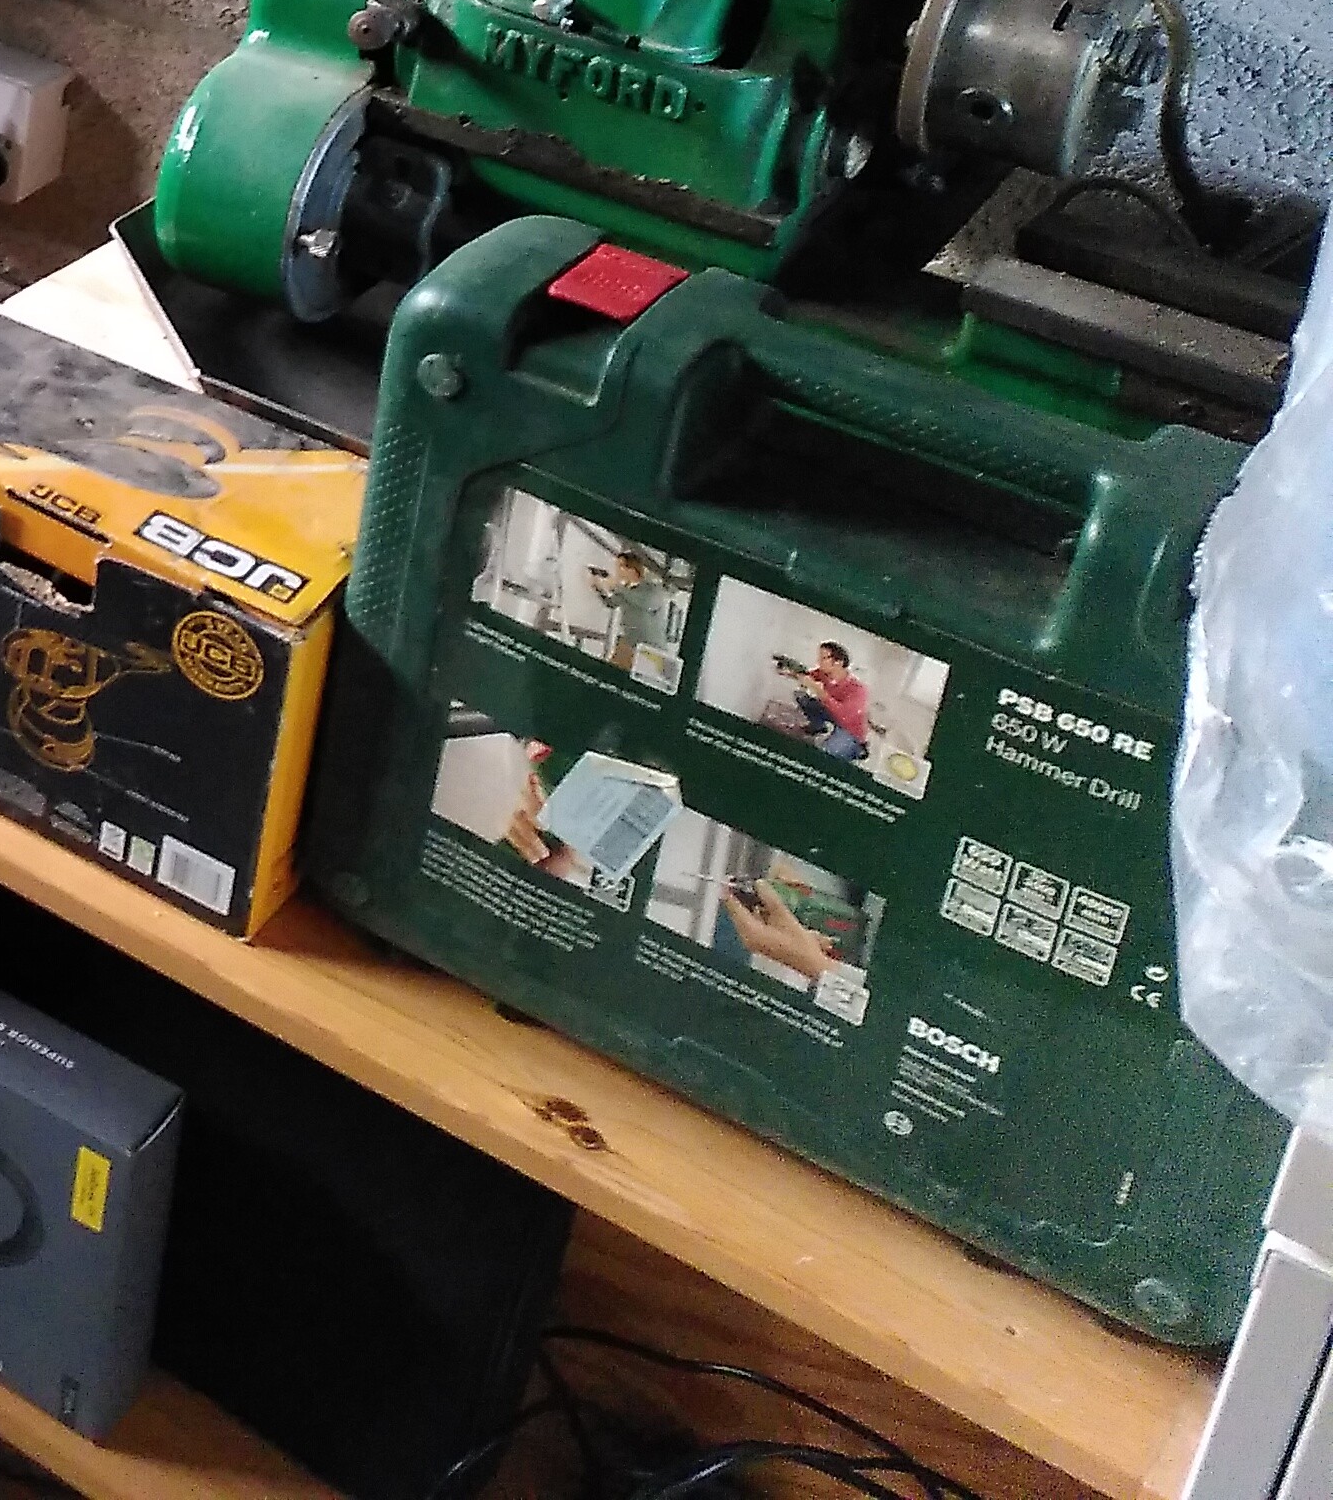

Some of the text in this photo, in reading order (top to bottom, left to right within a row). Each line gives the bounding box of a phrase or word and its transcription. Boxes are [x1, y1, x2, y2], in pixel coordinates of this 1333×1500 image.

[483, 22, 688, 122] MYFORD
[29, 484, 103, 524] JCB
[139, 513, 304, 595] JCB
[990, 712, 1069, 754] 650 W
[997, 687, 1156, 762] PSB 650 RE
[984, 735, 1143, 811] Hammer Drill
[6, 1028, 75, 1070] SUPERIOR
[907, 1016, 1002, 1074] BOSCH
